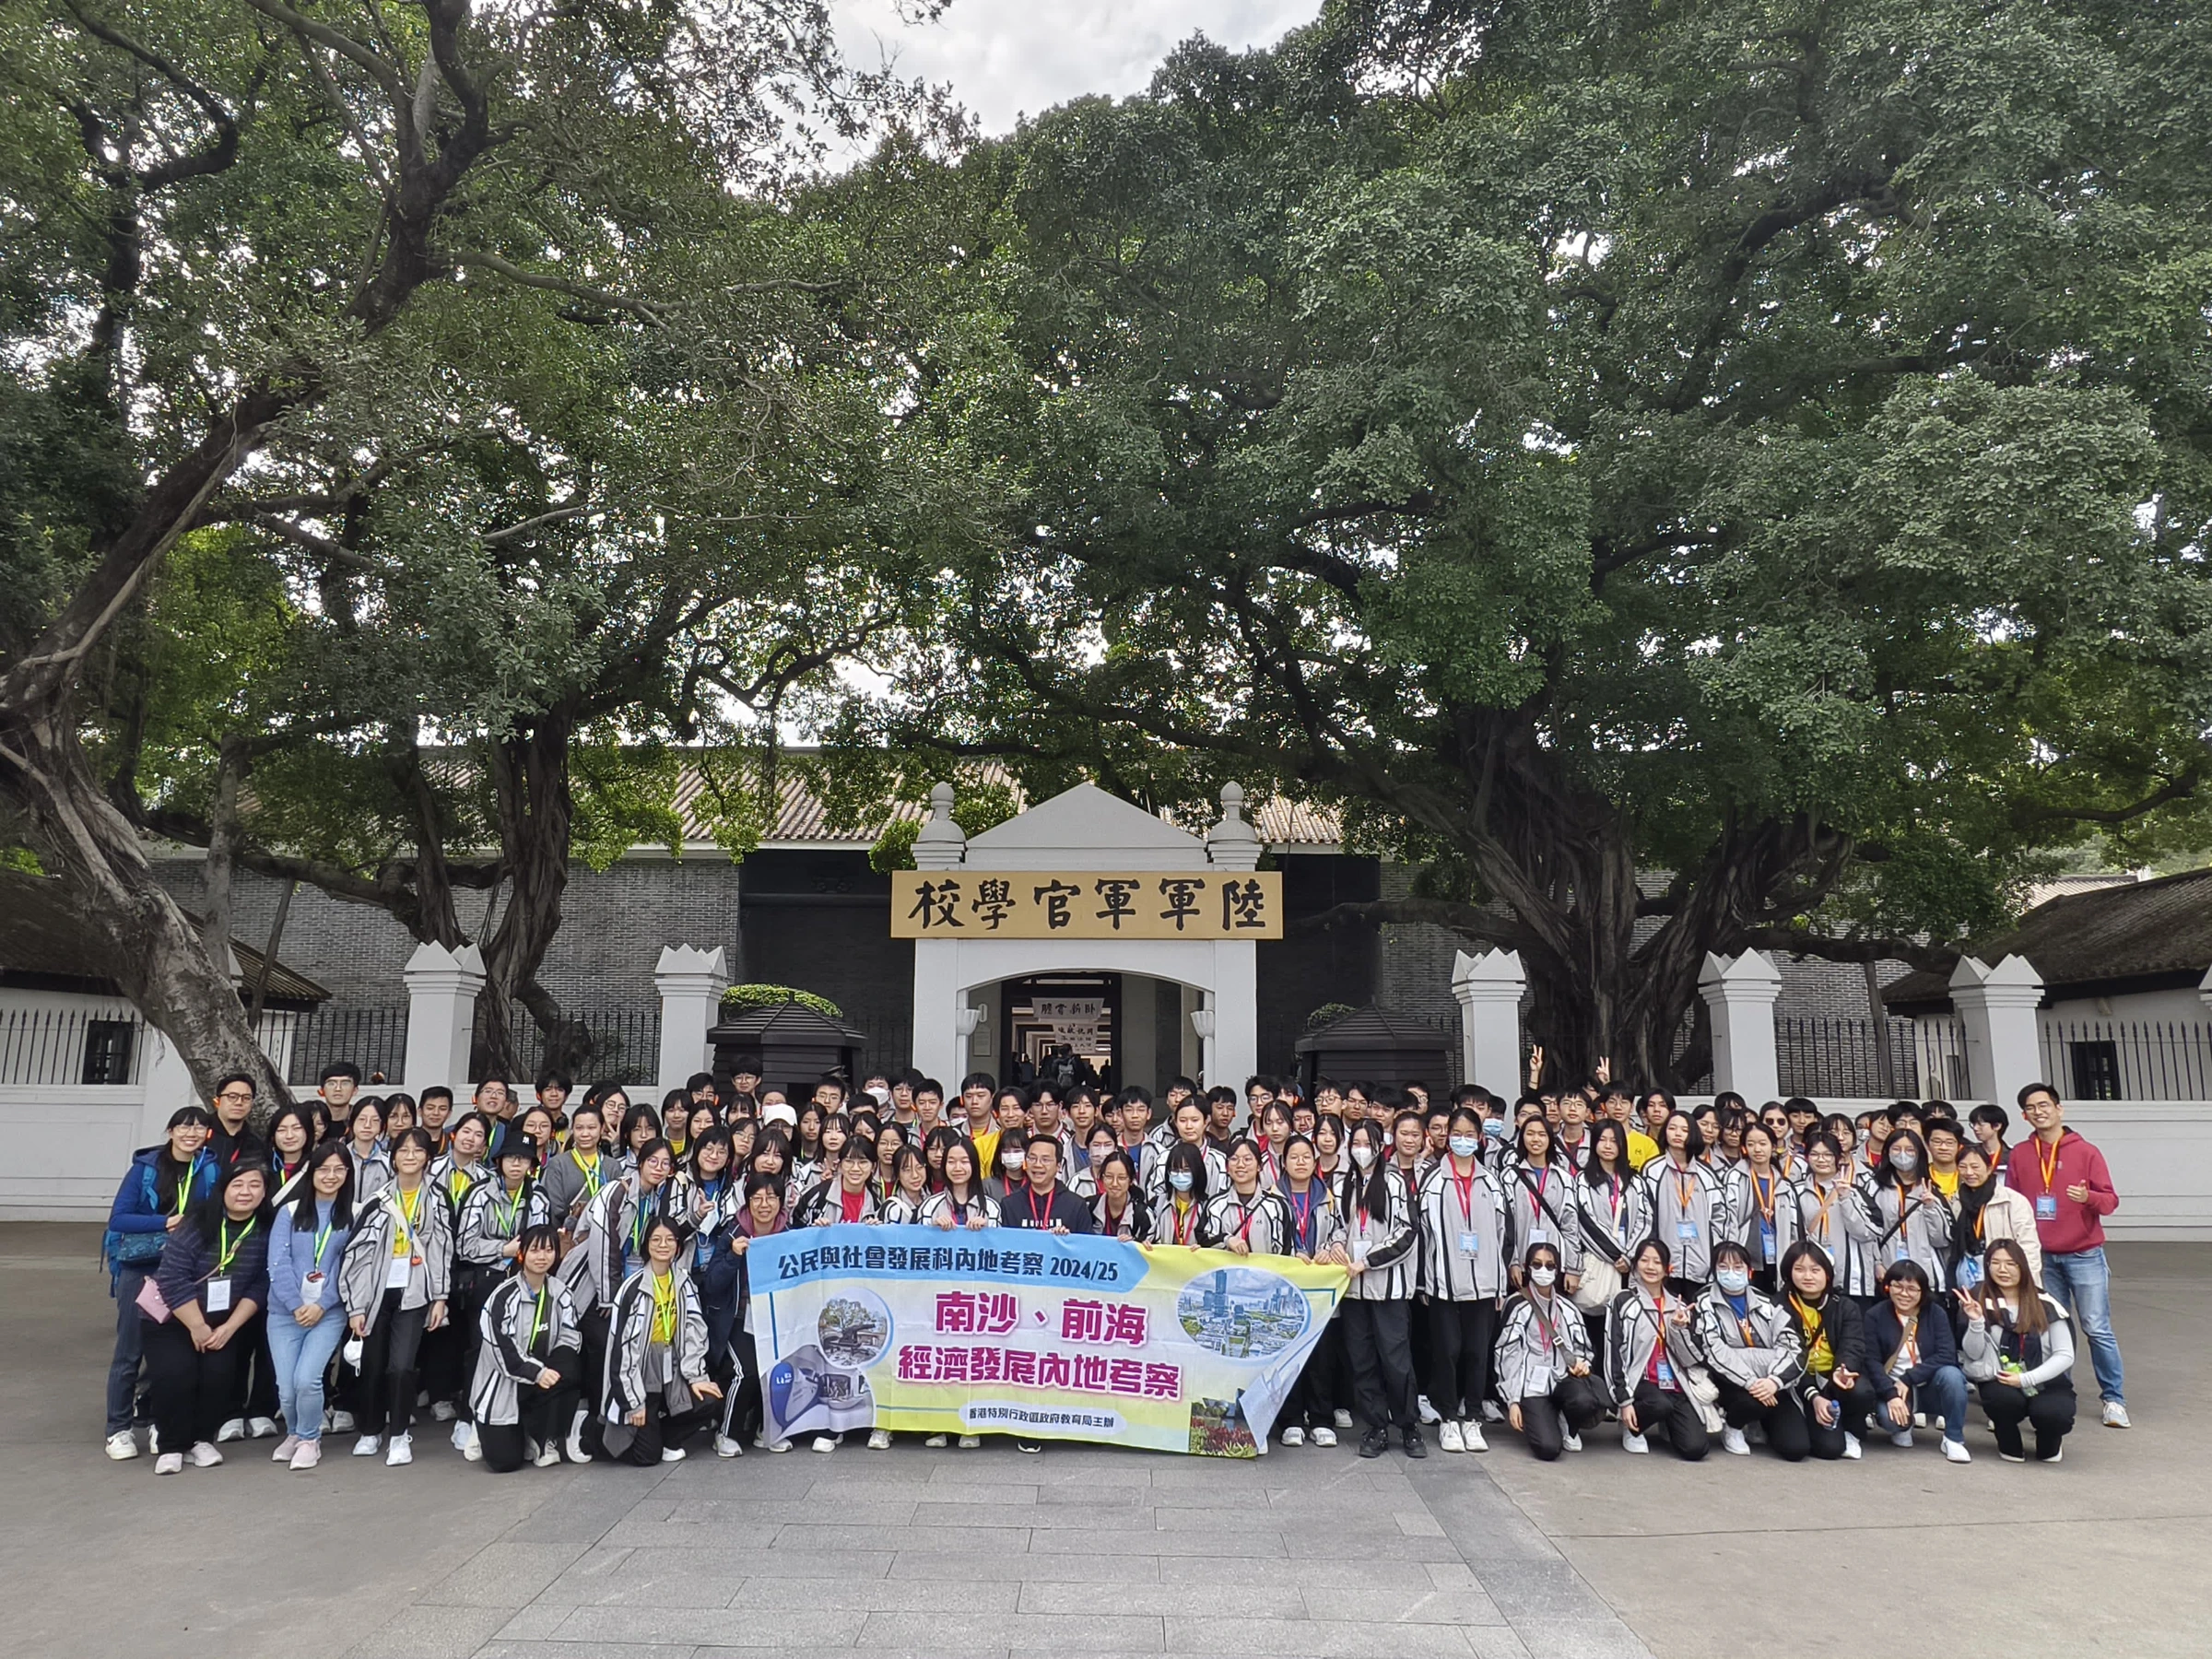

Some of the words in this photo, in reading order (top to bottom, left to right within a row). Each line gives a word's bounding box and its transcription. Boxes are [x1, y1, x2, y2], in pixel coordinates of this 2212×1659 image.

[908, 878, 1266, 931] 陸軍軍官學校
[778, 1244, 1043, 1279] 公民與社會發展科內地考察
[1049, 1256, 1119, 1281] 2024/25
[935, 1290, 1147, 1345] 南沙、前海
[898, 1345, 1180, 1398] 經濟發展內地考察
